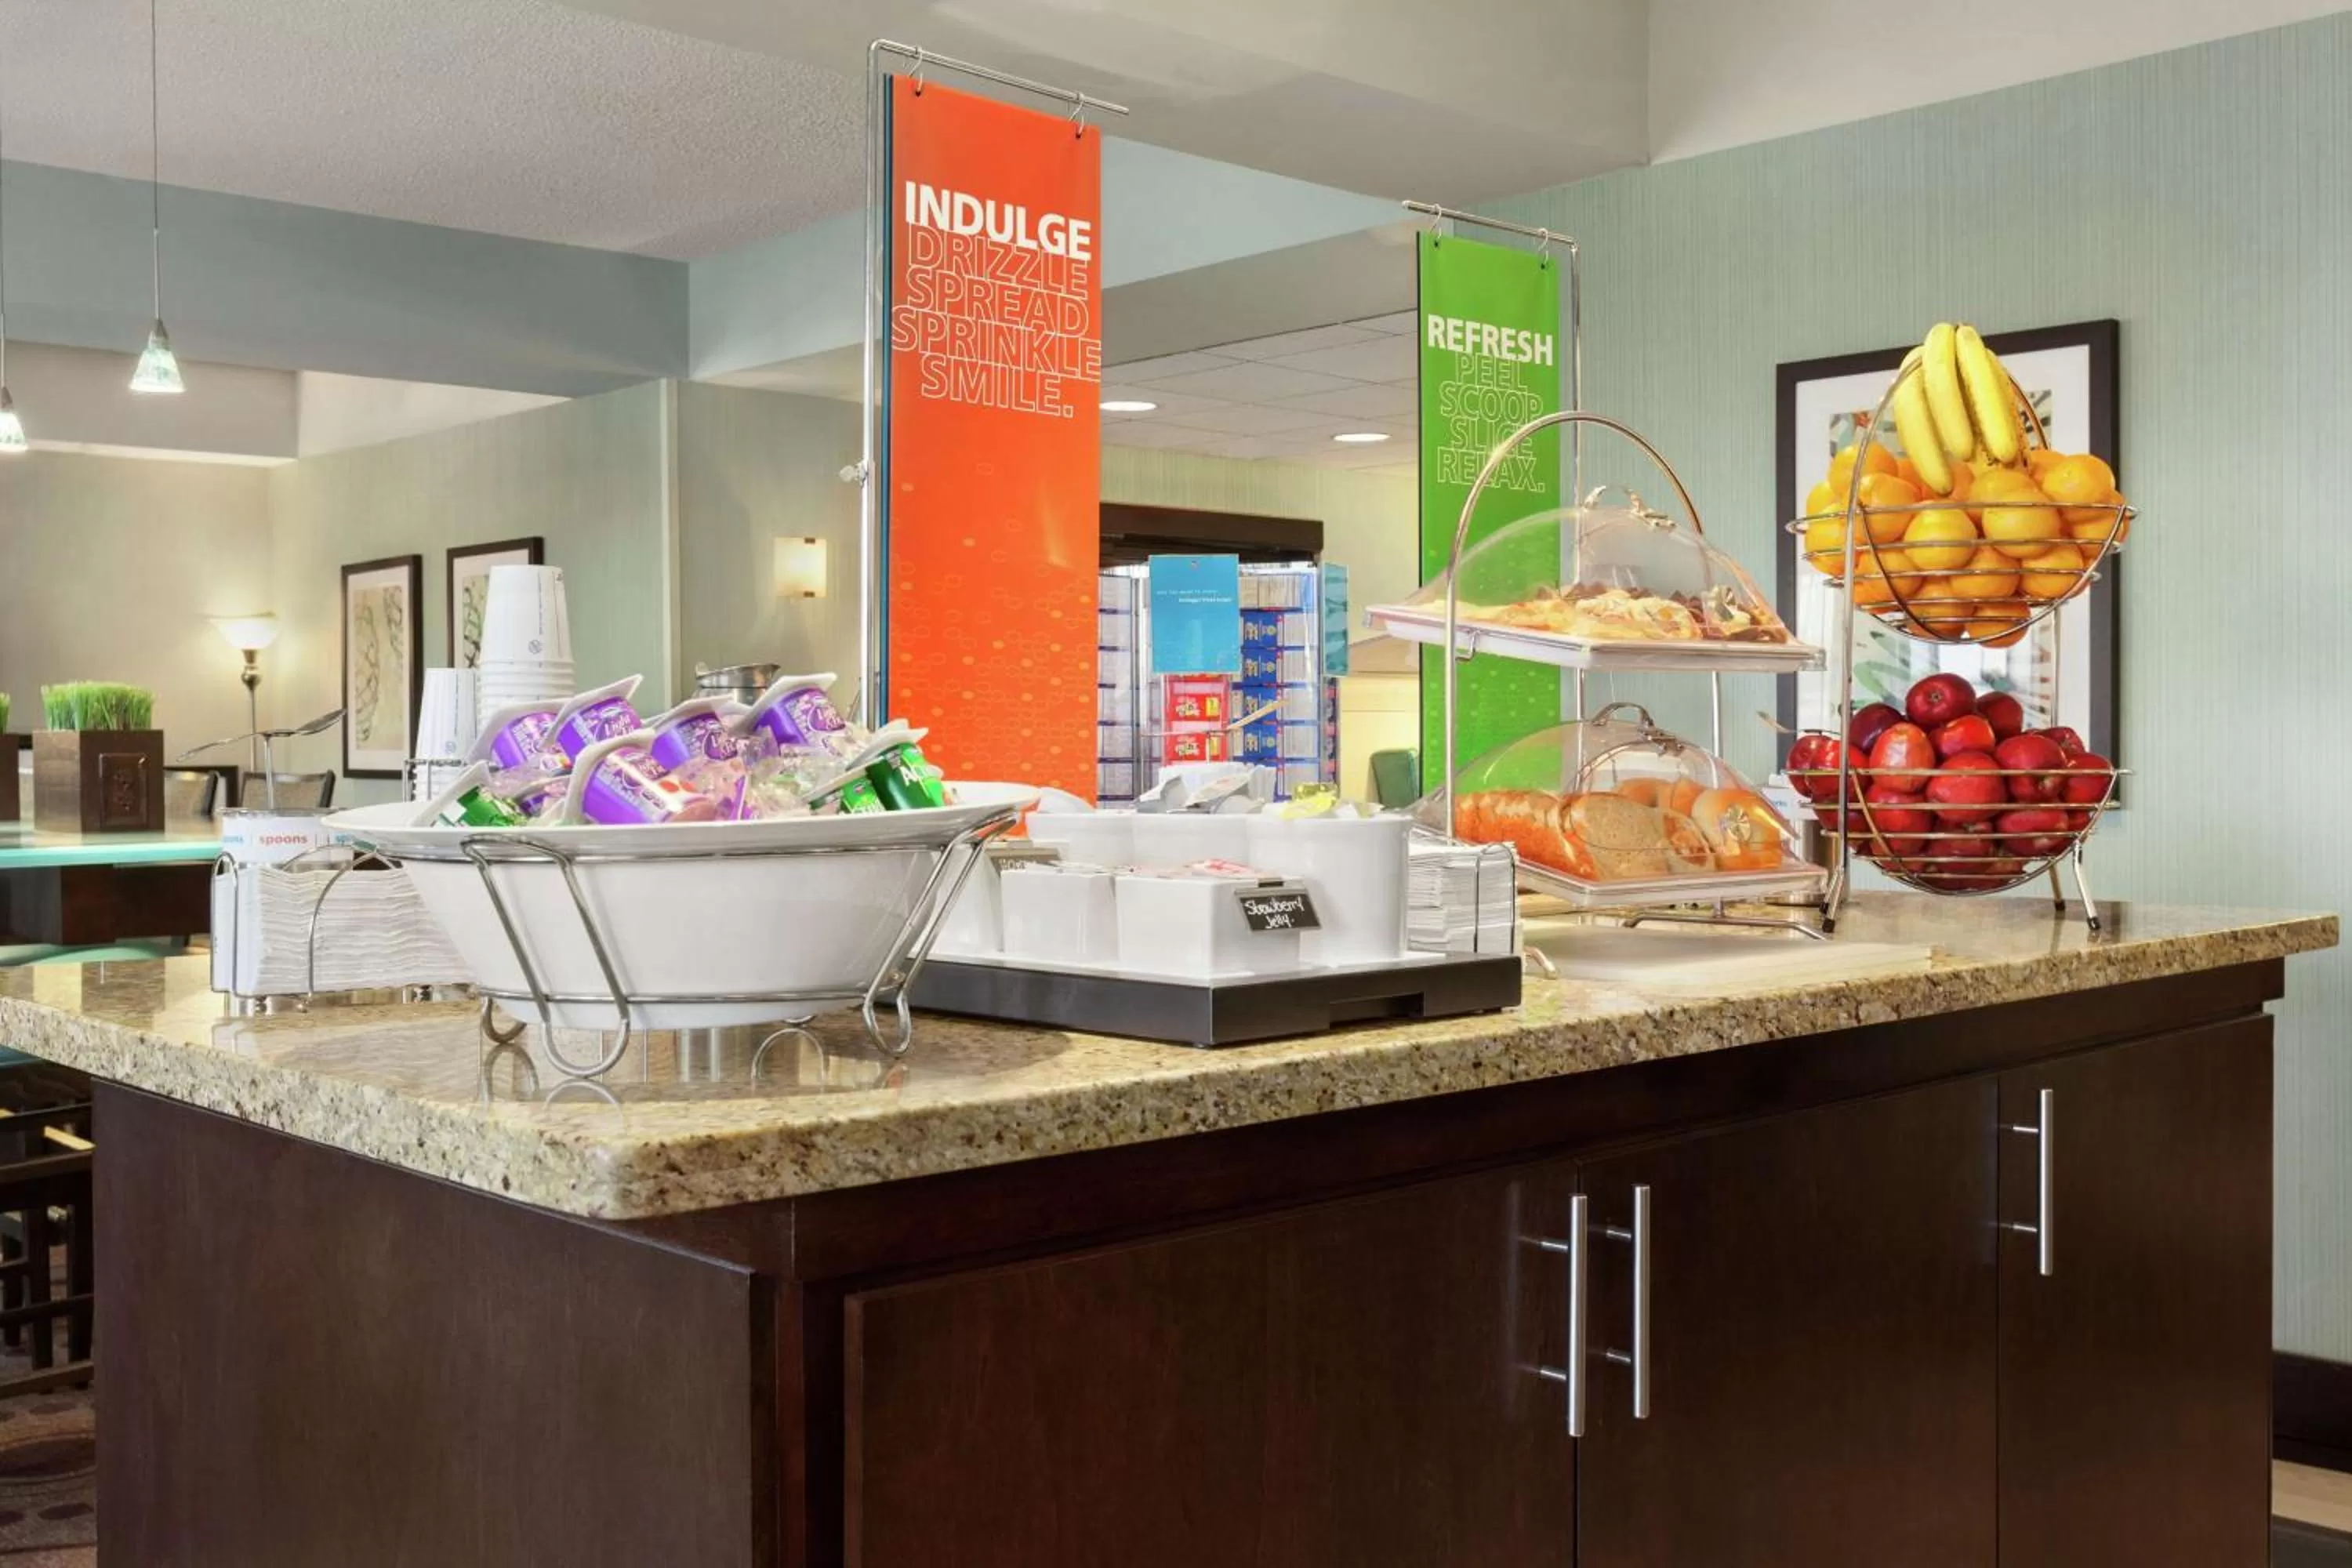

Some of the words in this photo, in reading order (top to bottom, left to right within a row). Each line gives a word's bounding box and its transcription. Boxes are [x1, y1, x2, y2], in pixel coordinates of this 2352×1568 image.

[906, 181, 1091, 261] INDULGE
[909, 223, 1088, 300] DRIZZLE
[906, 267, 1089, 339] SPREAD
[891, 304, 1101, 383] SPRINKLE
[1427, 314, 1554, 366] REFRESH
[1455, 351, 1528, 391] PEEL
[920, 353, 1074, 419] SMILE.
[1439, 381, 1544, 425] SCOOP
[259, 833, 308, 845] spoons
